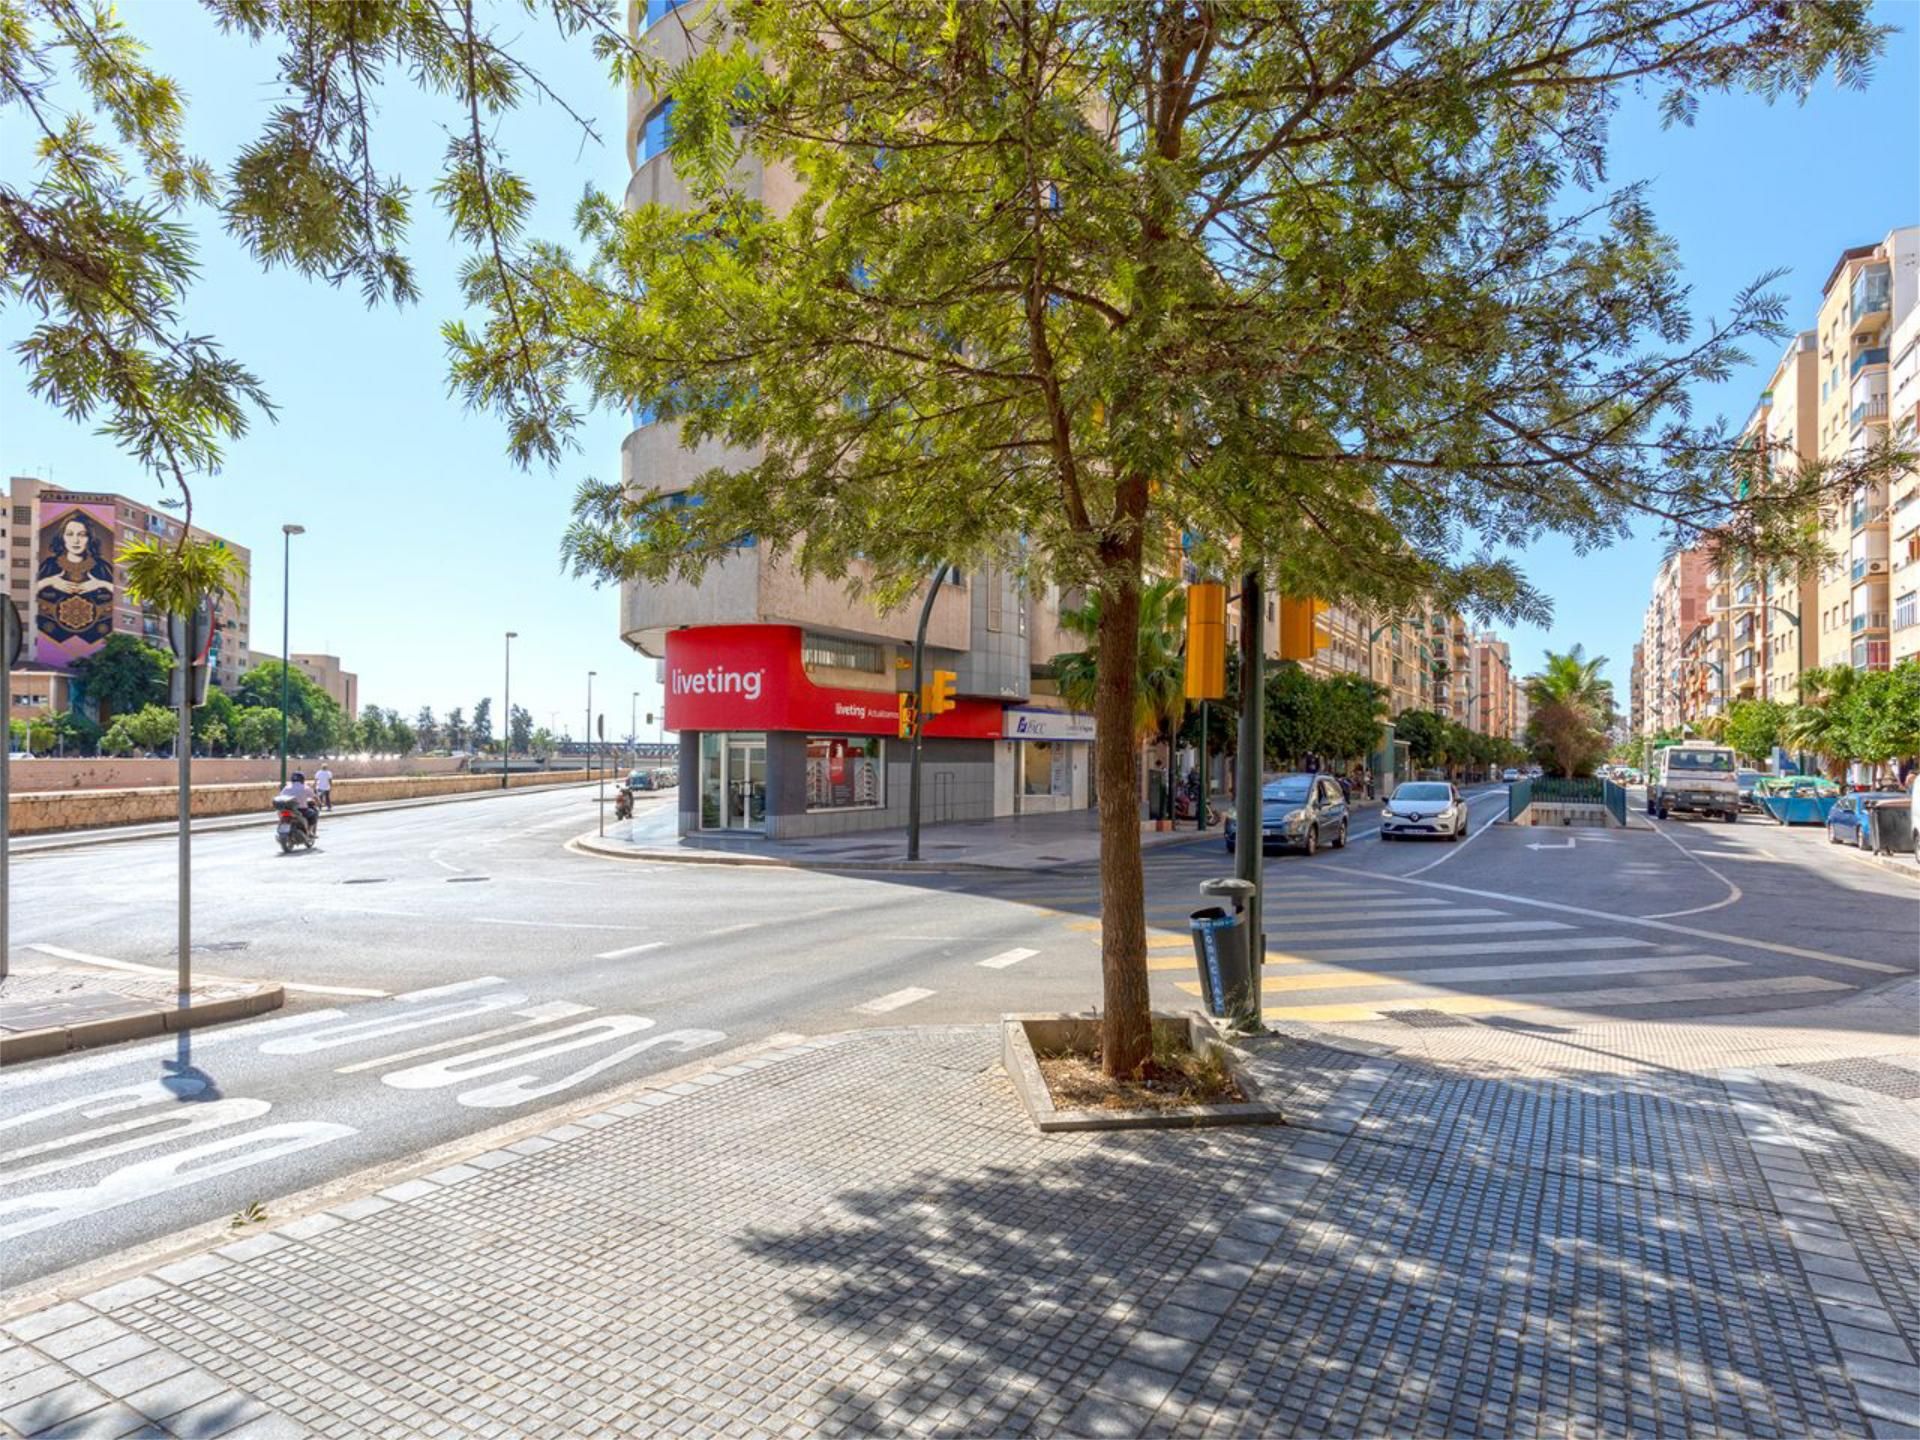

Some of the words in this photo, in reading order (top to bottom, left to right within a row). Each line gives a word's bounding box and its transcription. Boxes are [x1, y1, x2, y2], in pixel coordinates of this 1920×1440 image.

[672, 665, 762, 700] liveting
[835, 702, 865, 719] liveting
[1205, 935, 1223, 1008] GRACIAS
